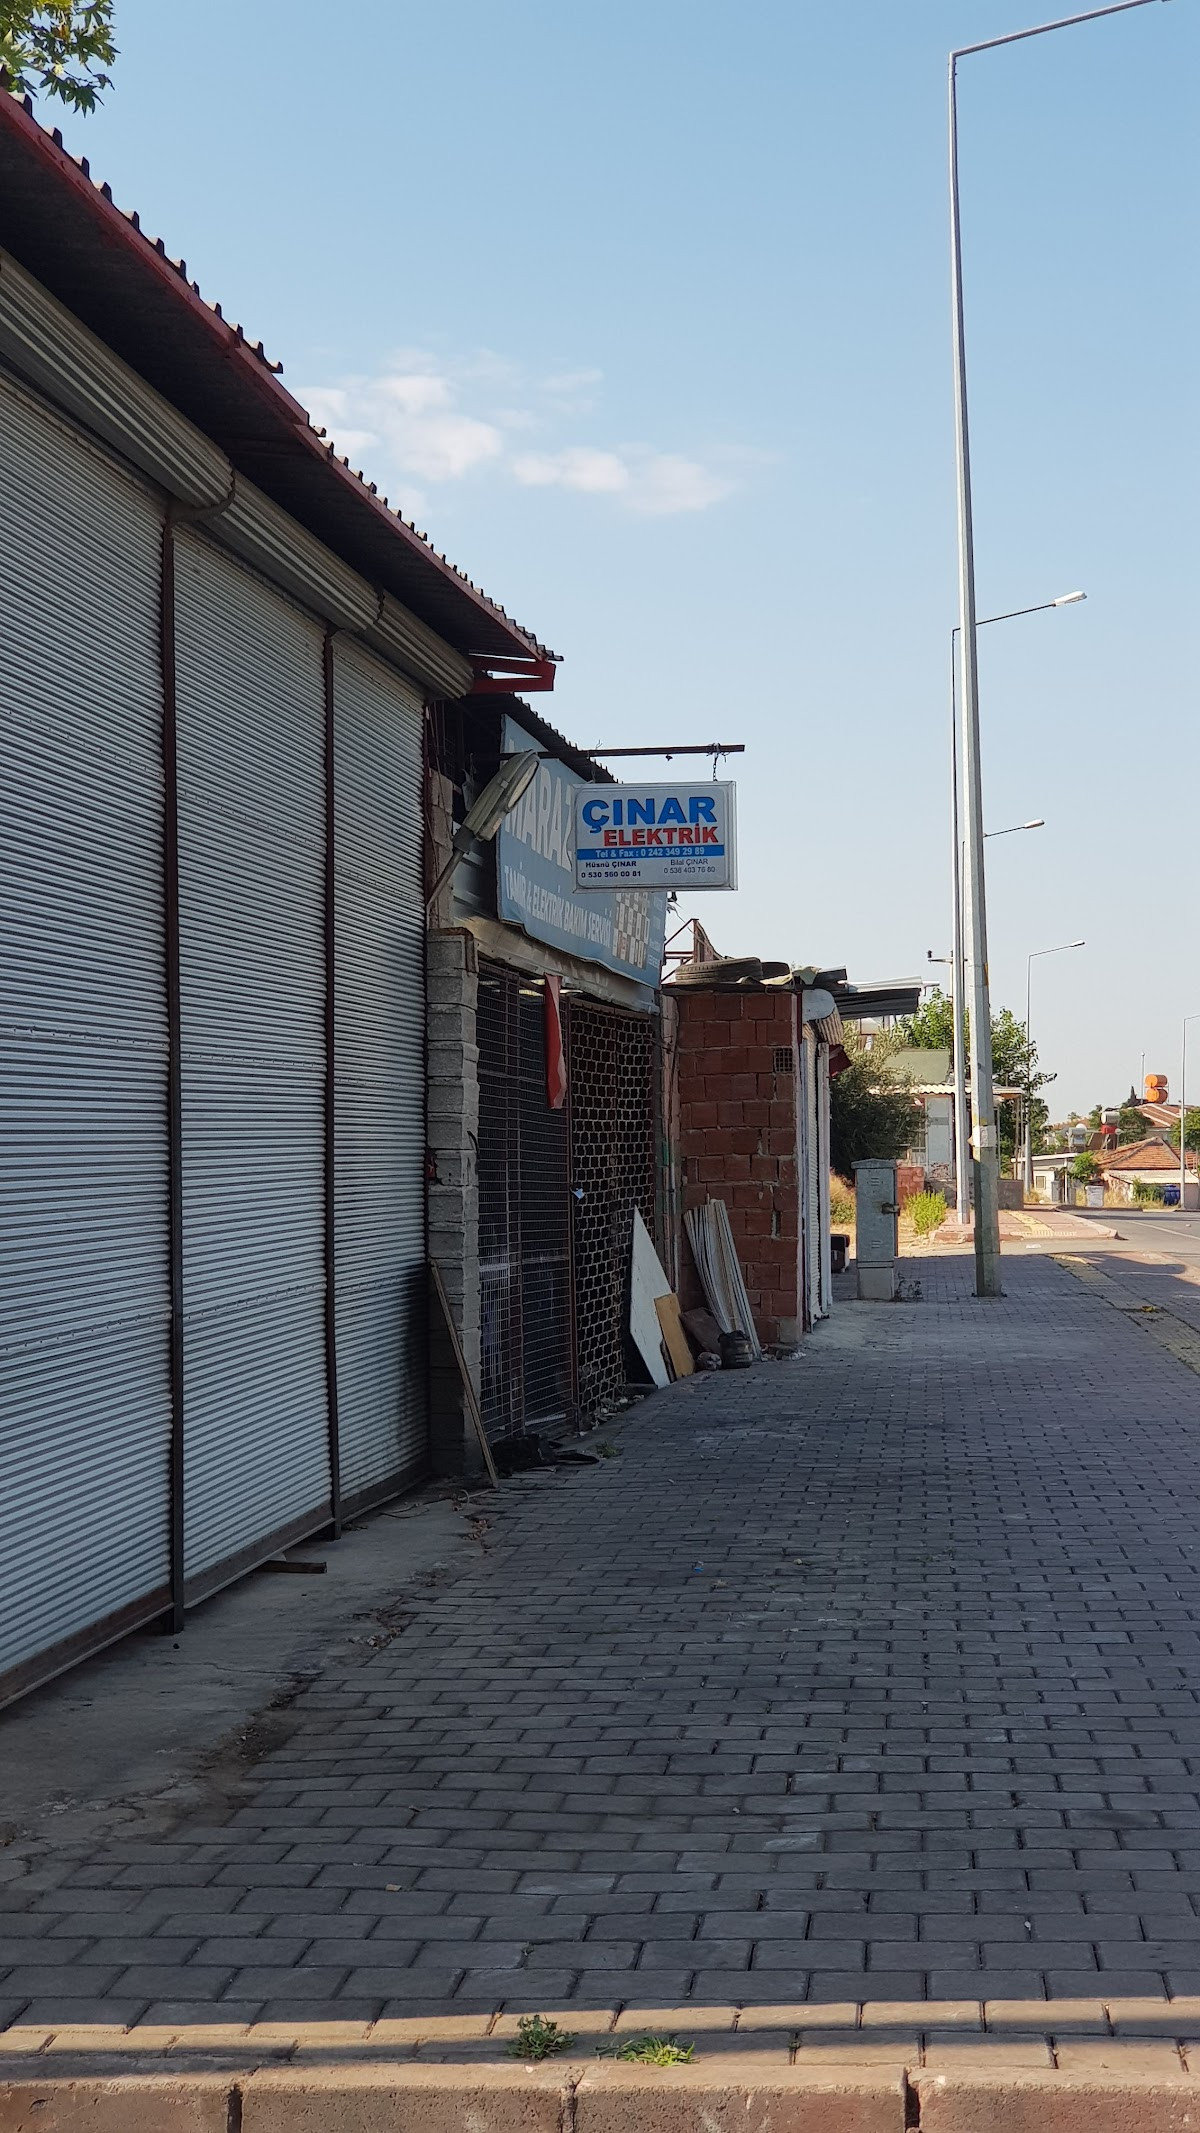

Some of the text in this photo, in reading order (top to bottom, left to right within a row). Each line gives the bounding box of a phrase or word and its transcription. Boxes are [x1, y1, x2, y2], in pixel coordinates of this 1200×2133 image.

[582, 796, 718, 833] ÇINAR
[604, 823, 719, 846] ELEKTRİK
[595, 849, 609, 858] Tel
[610, 849, 617, 858] &
[619, 849, 634, 857] Fax
[640, 848, 646, 857] 0
[648, 848, 664, 857] 242
[665, 847, 680, 856] 349
[682, 847, 692, 856] 29
[694, 846, 705, 855] 89
[611, 860, 637, 869] ÇINAR
[685, 858, 708, 866] ÇINAR
